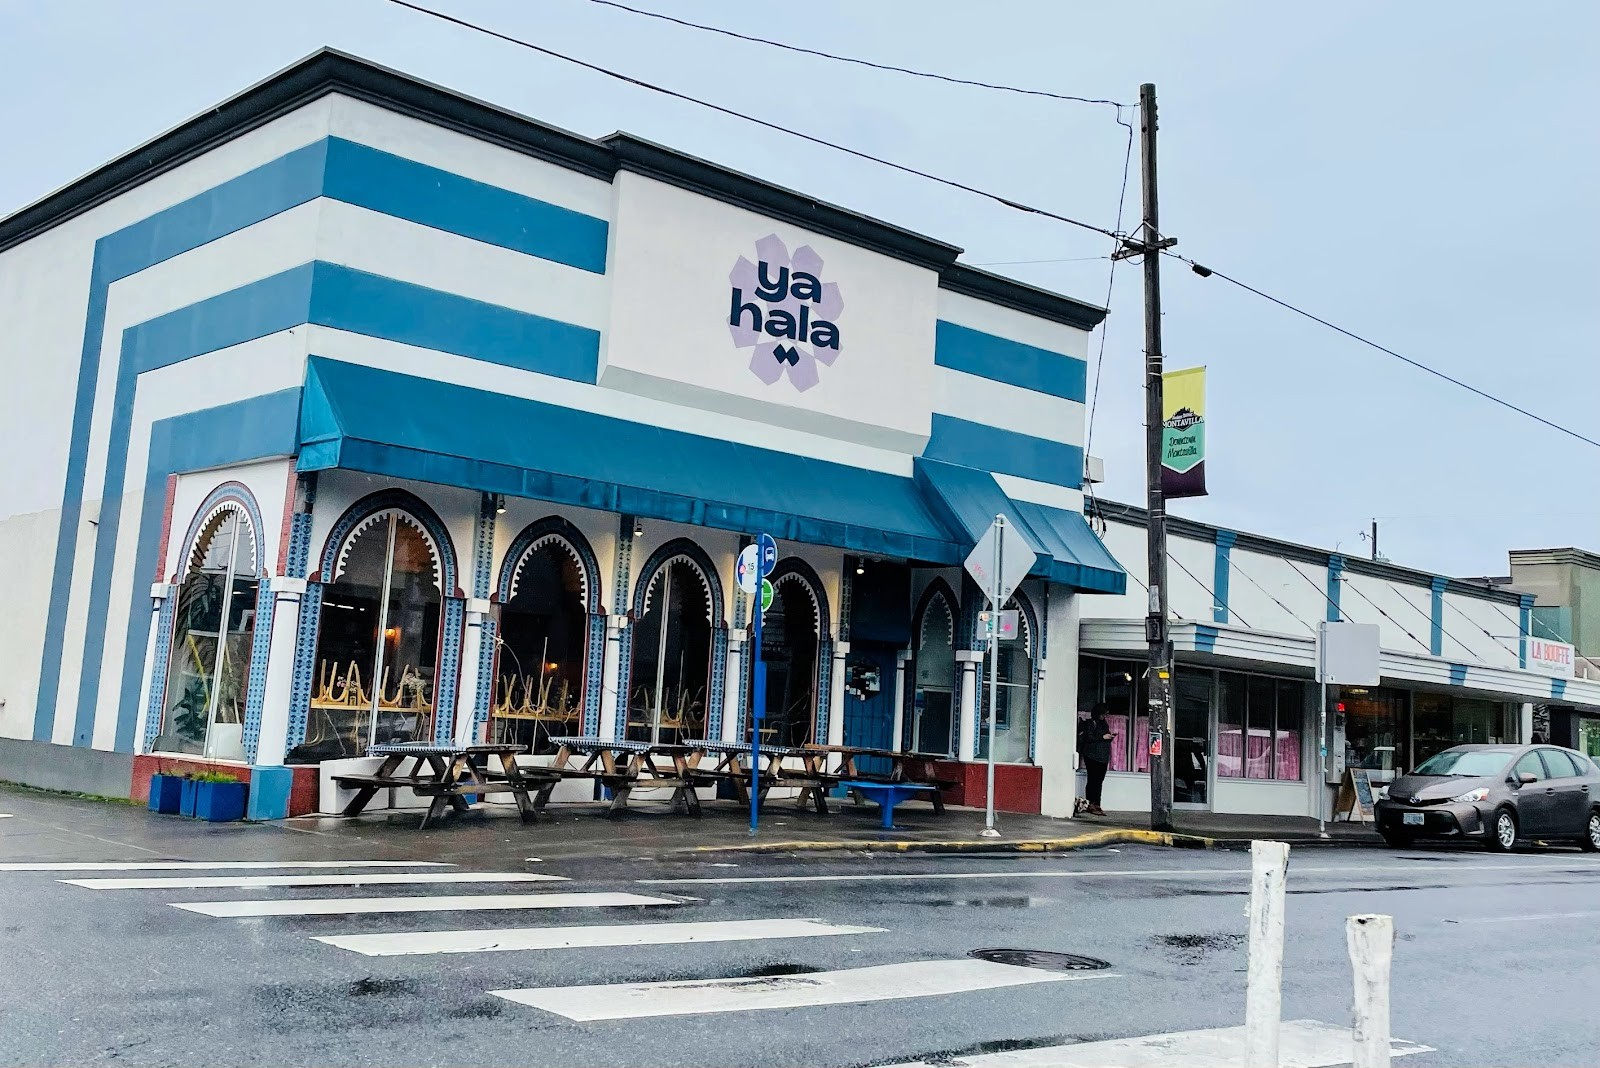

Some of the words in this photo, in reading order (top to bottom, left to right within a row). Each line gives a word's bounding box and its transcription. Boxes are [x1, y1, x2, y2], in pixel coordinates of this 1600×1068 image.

[755, 260, 822, 304] ya
[730, 287, 840, 351] hala
[1531, 640, 1542, 660] LA
